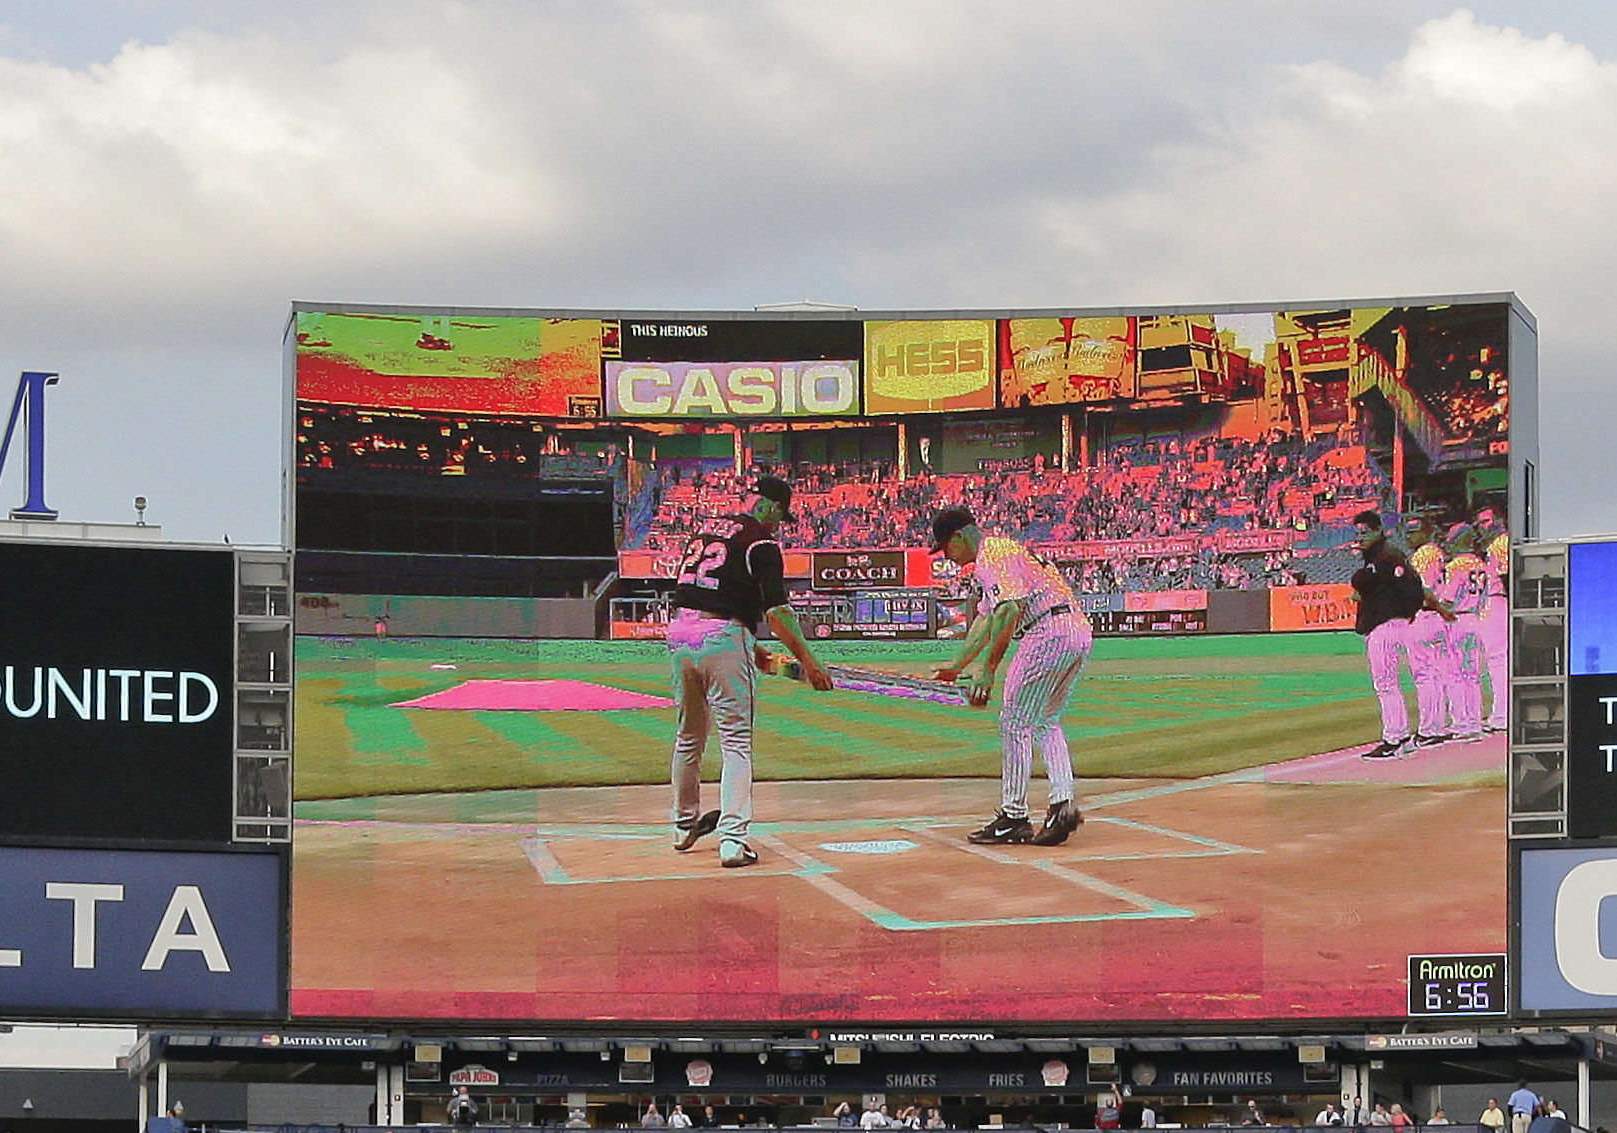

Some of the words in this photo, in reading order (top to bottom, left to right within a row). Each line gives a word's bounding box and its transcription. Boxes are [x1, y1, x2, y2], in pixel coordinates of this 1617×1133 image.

[631, 325, 657, 337] THIS
[877, 339, 983, 377] HESS
[617, 365, 854, 414] CASIO
[1420, 960, 1494, 980] Armitron
[537, 1074, 569, 1085] PIZZA
[767, 1073, 826, 1087] BURGERS
[886, 1073, 937, 1087] SHAKES
[989, 1073, 1024, 1086] FRIES
[1174, 1071, 1200, 1085] FAN
[1203, 1071, 1272, 1086] FAVORITES
